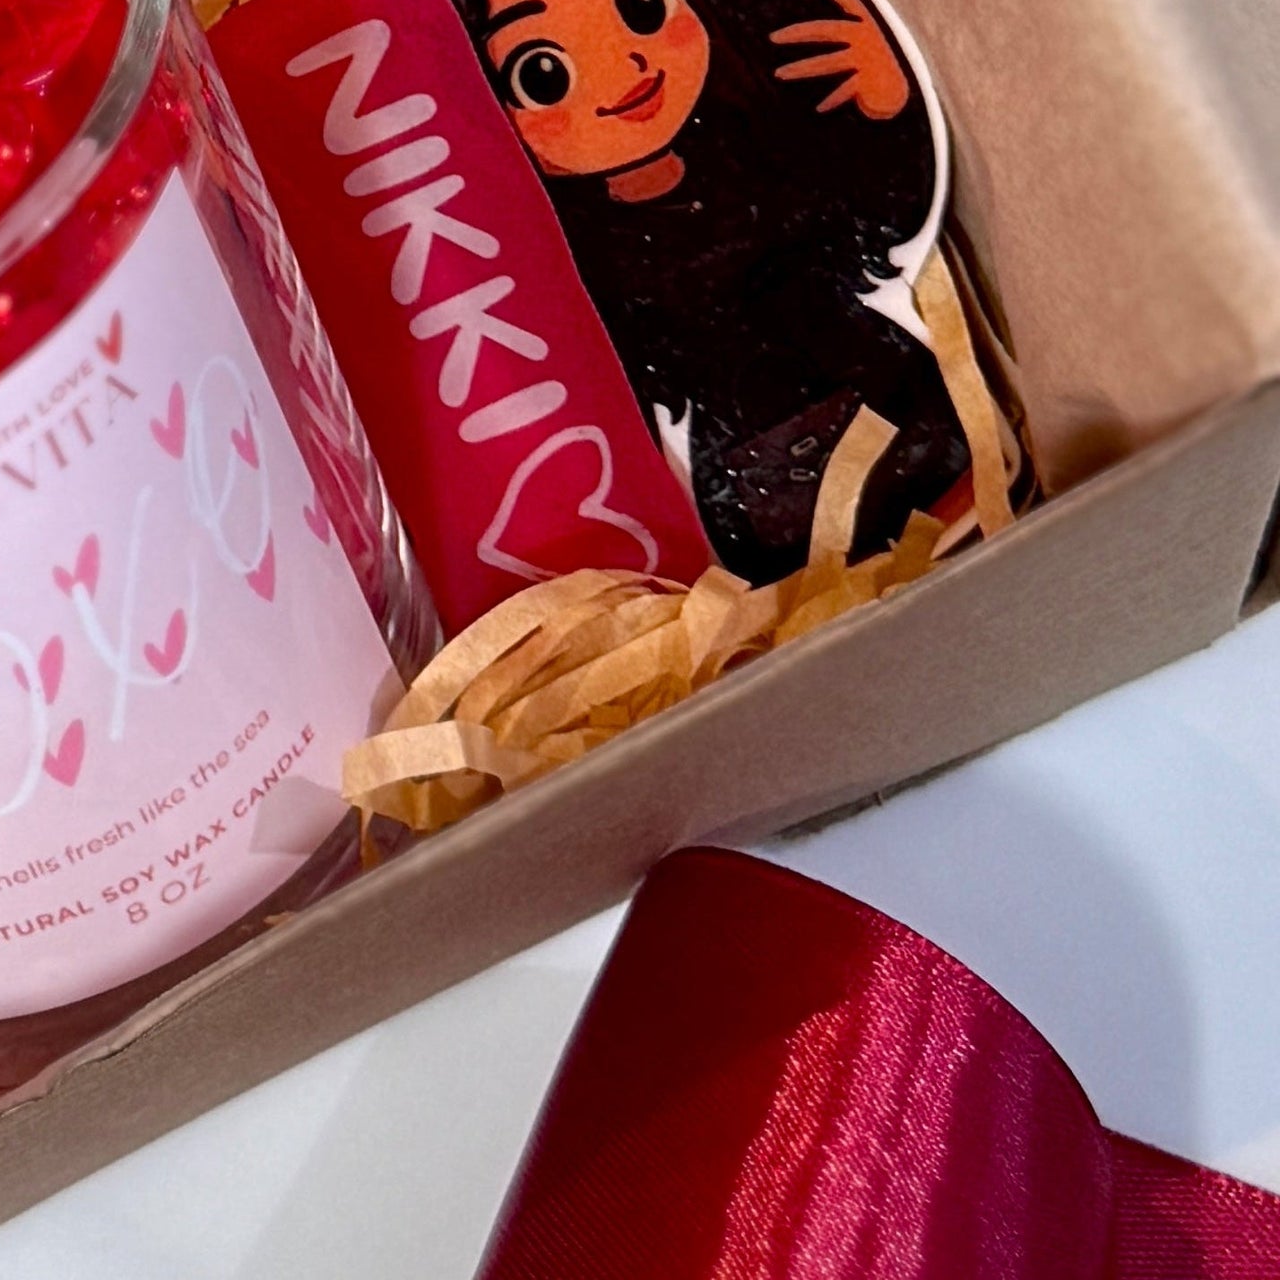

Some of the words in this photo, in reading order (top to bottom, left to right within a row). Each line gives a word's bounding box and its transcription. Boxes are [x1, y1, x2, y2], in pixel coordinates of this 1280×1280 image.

[285, 17, 569, 444] NIKKI
[0, 373, 140, 491] VITA
[36, 358, 94, 417] LOVE
[64, 819, 136, 867] fresh
[139, 786, 187, 825] like
[190, 750, 230, 789] the
[233, 709, 271, 753] sea
[100, 864, 157, 906] SOY
[163, 818, 228, 869] WAX
[231, 722, 316, 820] CANDLE
[125, 901, 149, 925] 8
[159, 861, 212, 907] OZ
